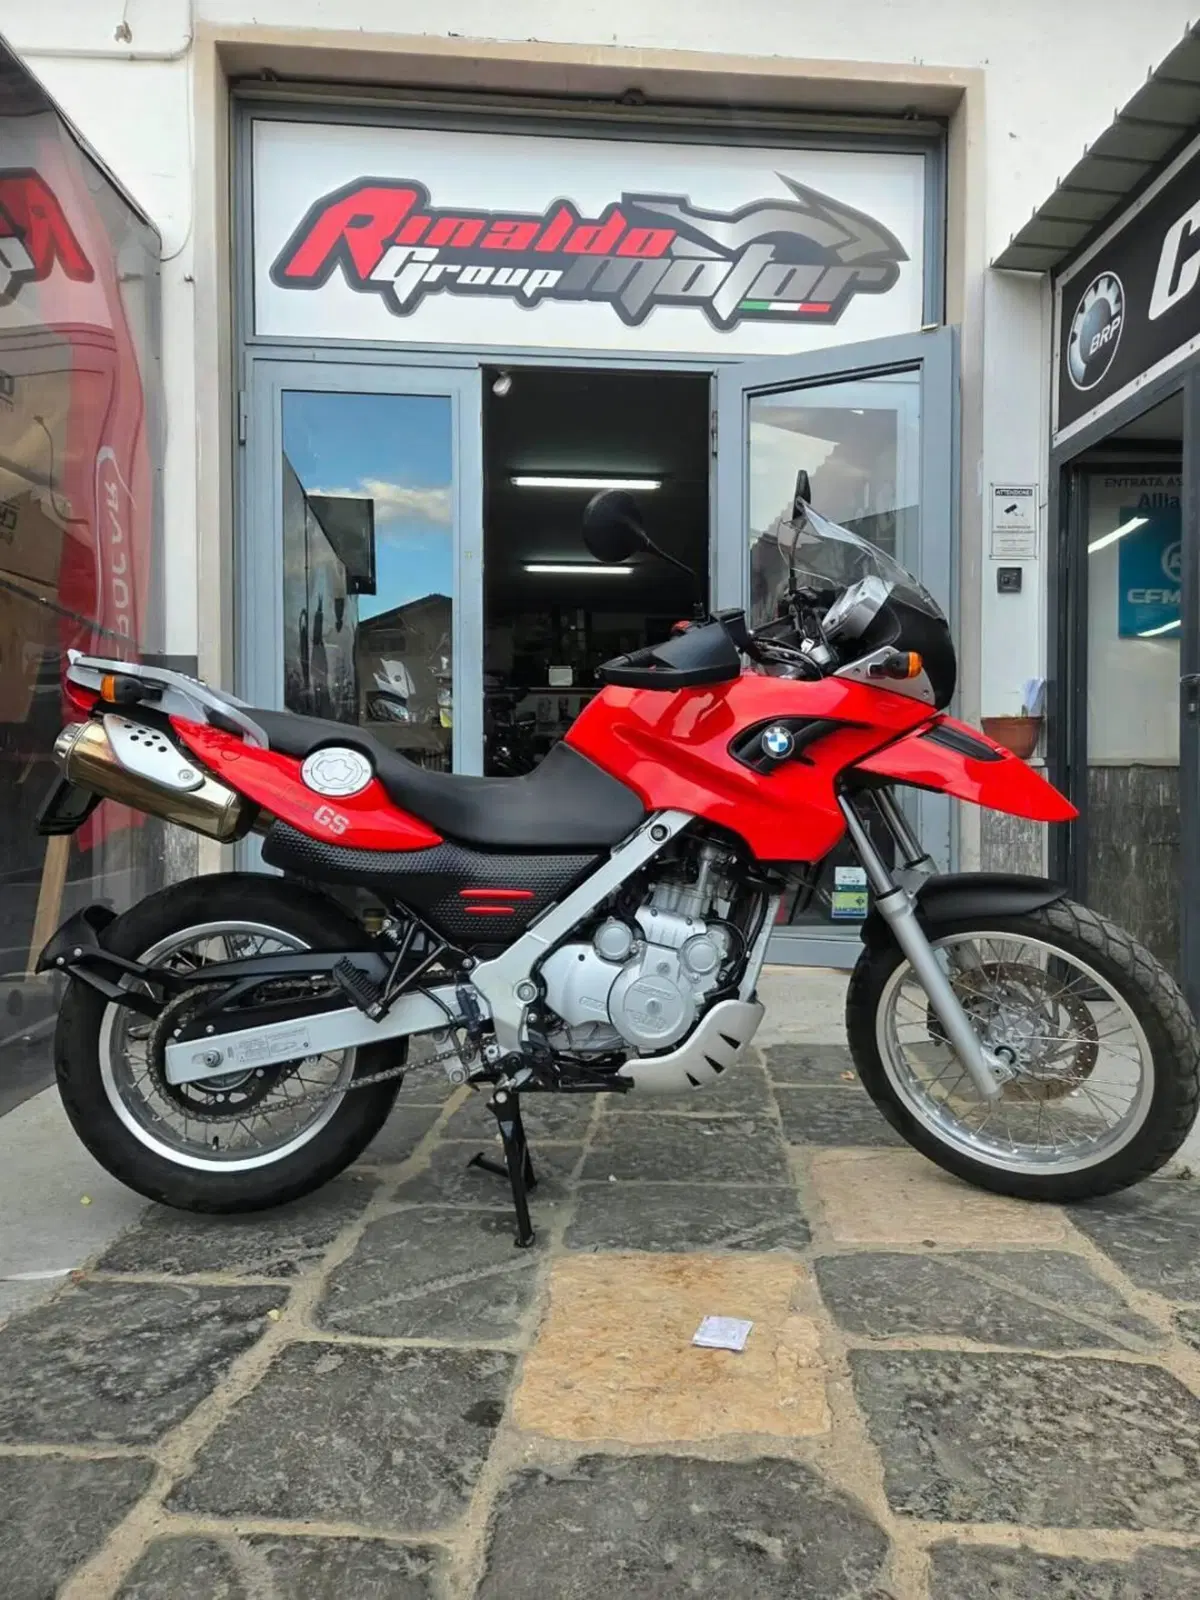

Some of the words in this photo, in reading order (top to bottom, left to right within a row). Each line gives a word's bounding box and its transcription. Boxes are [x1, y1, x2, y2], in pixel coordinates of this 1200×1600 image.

[285, 186, 678, 280] Rinaldo
[369, 245, 565, 305] Group
[1089, 315, 1121, 356] BRP
[313, 805, 350, 836] GS
